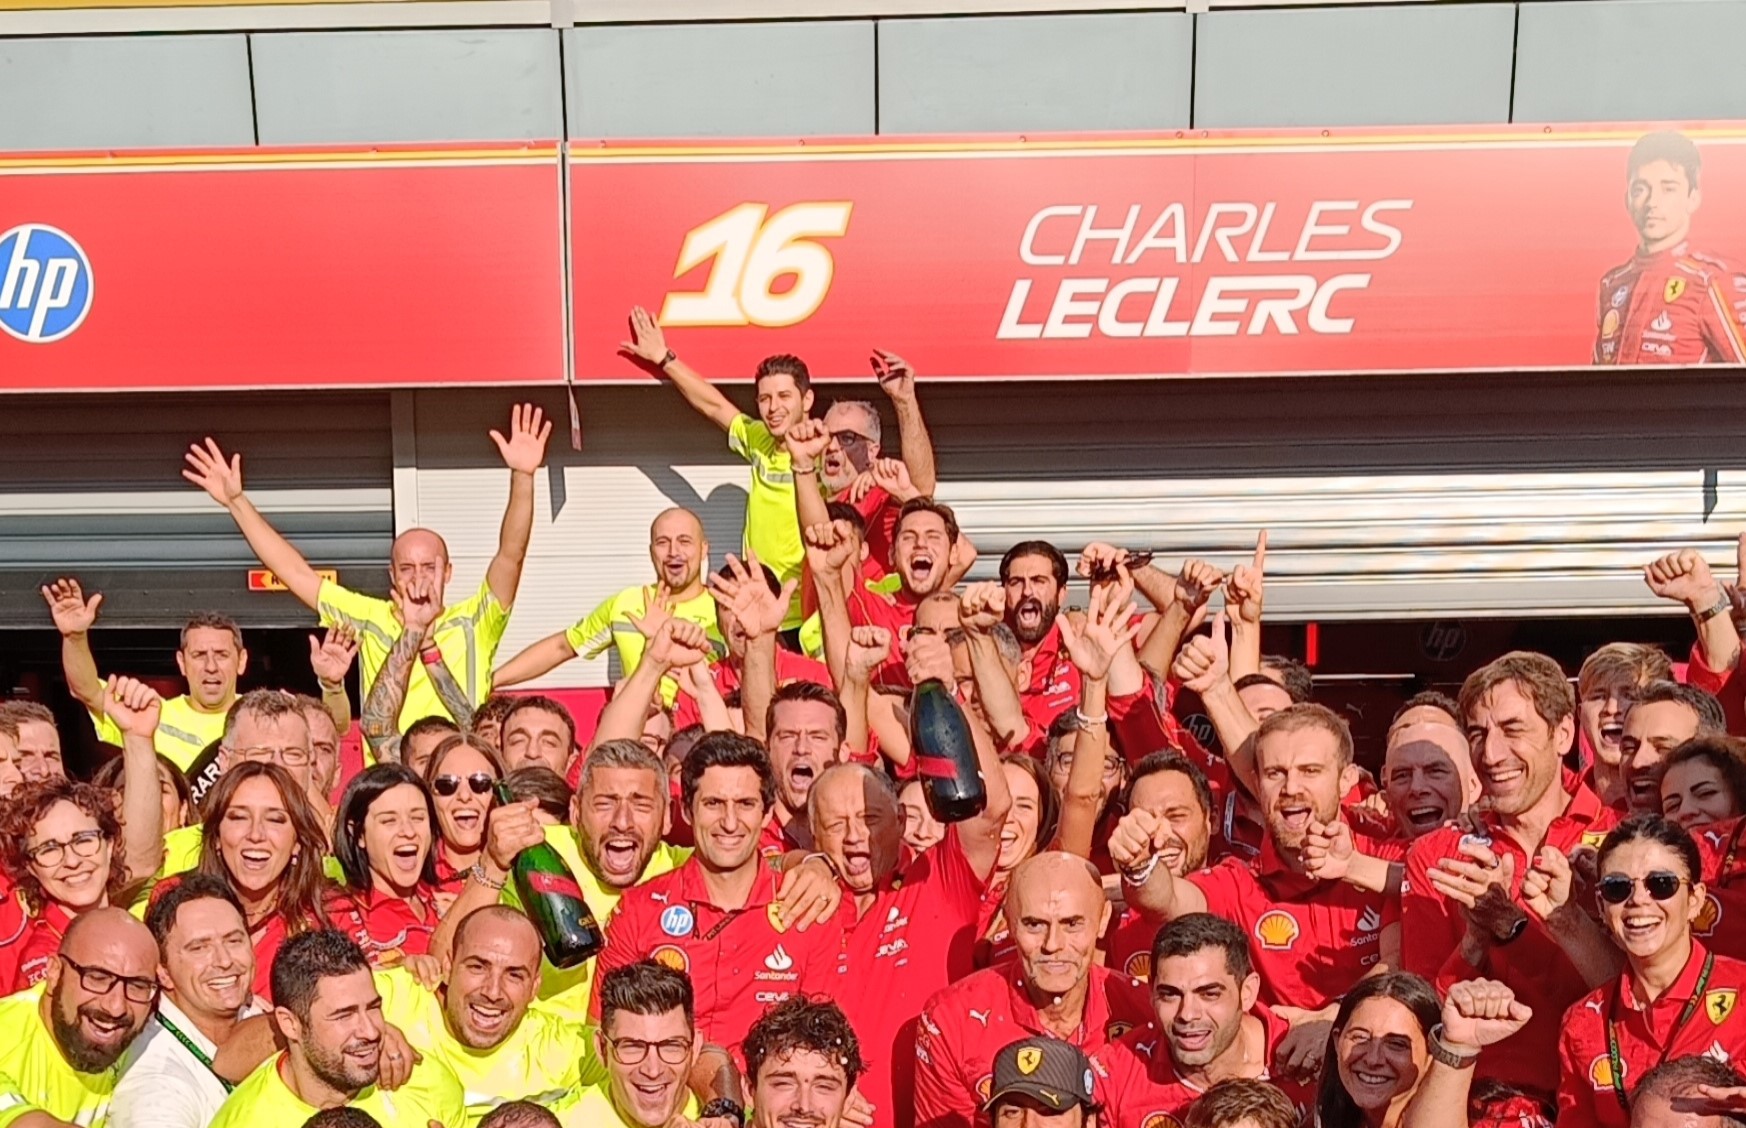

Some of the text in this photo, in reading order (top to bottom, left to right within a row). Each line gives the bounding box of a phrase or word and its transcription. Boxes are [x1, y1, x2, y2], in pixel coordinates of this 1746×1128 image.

[659, 200, 853, 327] 16
[1018, 199, 1414, 265] CHARLES
[0, 227, 79, 340] hp
[996, 272, 1372, 339] LECLERC
[191, 756, 220, 804] RAR
[667, 905, 689, 936] hp
